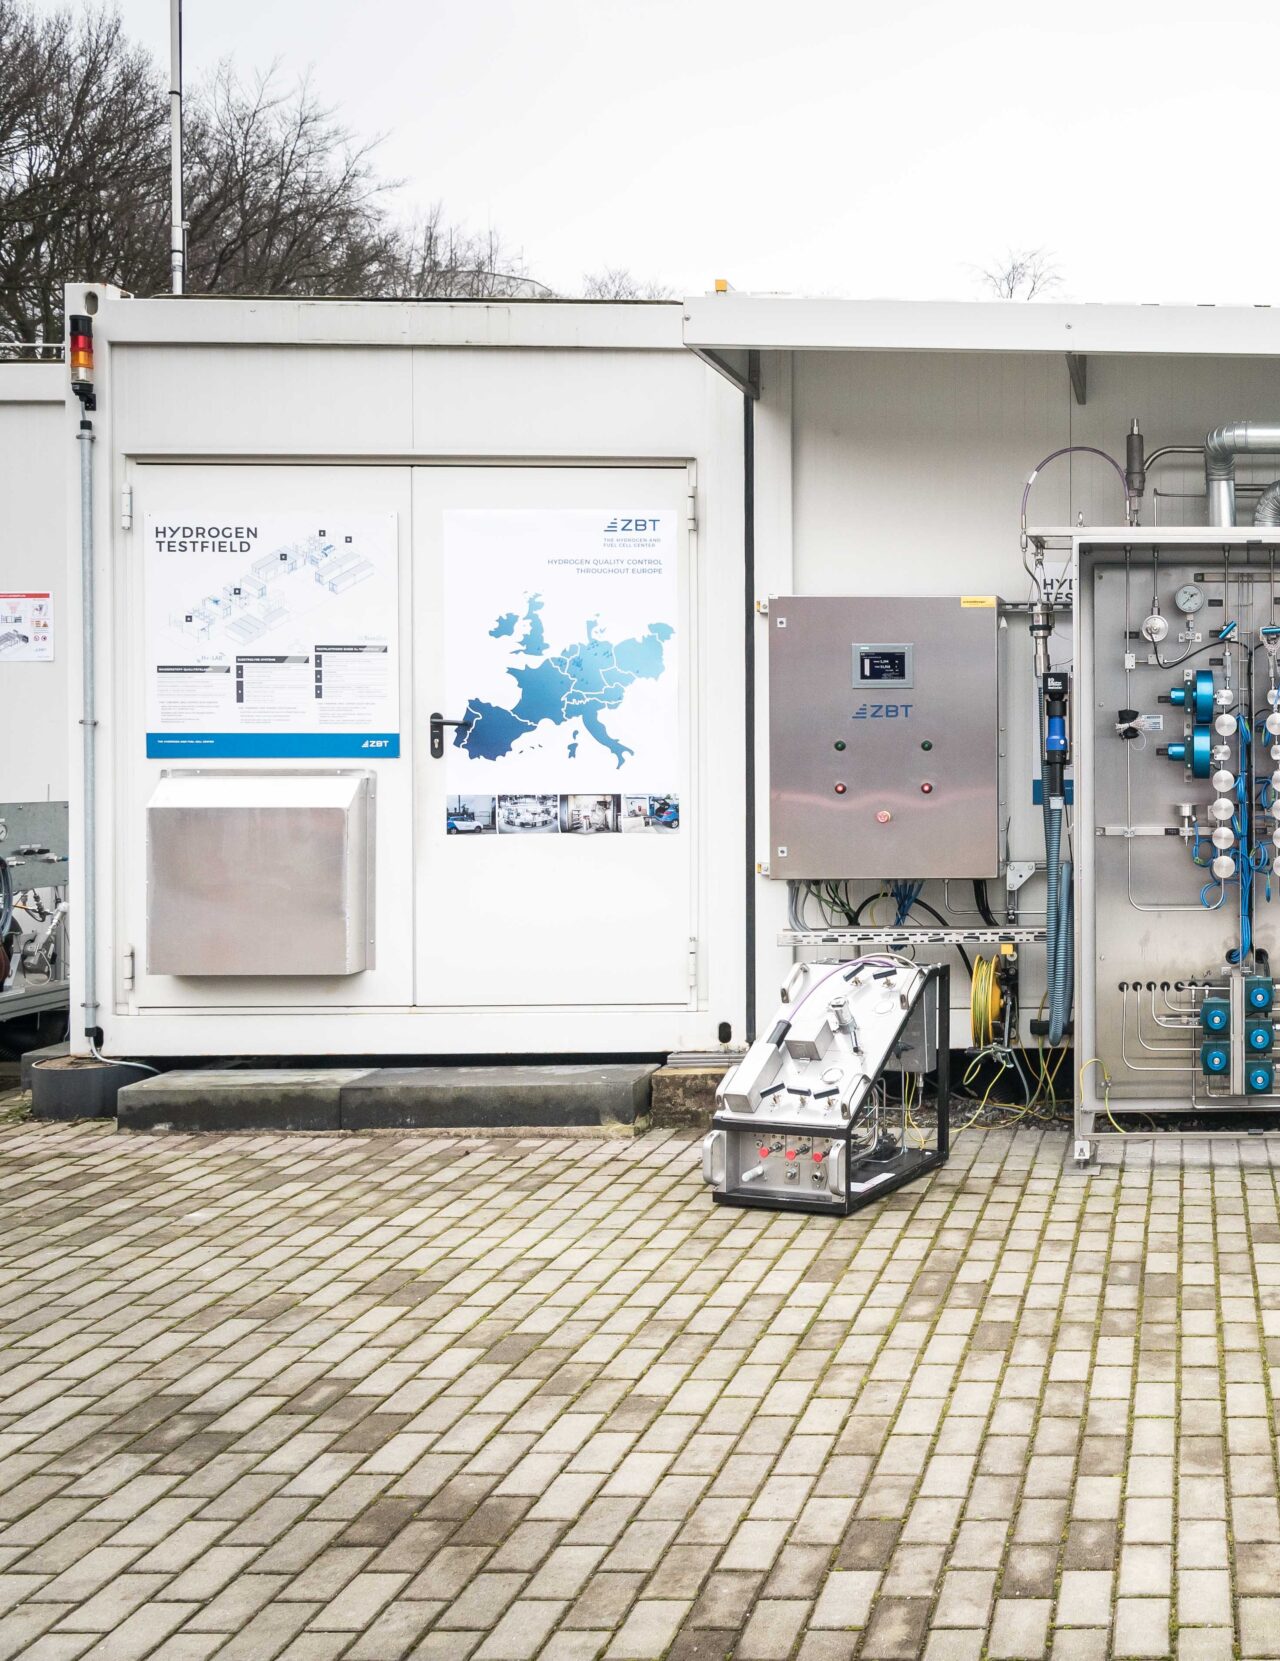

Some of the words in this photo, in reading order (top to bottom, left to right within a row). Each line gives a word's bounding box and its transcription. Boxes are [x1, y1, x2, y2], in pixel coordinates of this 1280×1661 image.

[620, 518, 661, 532] ZBT
[155, 526, 258, 539] HYDROGEN
[155, 540, 251, 553] TESTFIELD
[547, 558, 591, 566] HYDROGEN
[592, 558, 625, 566] QUALITY
[627, 558, 663, 566] CONTROL
[576, 567, 629, 575] THROUGHOUT
[631, 567, 663, 575] EUROPE
[870, 704, 914, 719] ZBT
[369, 740, 390, 748] ZBT
